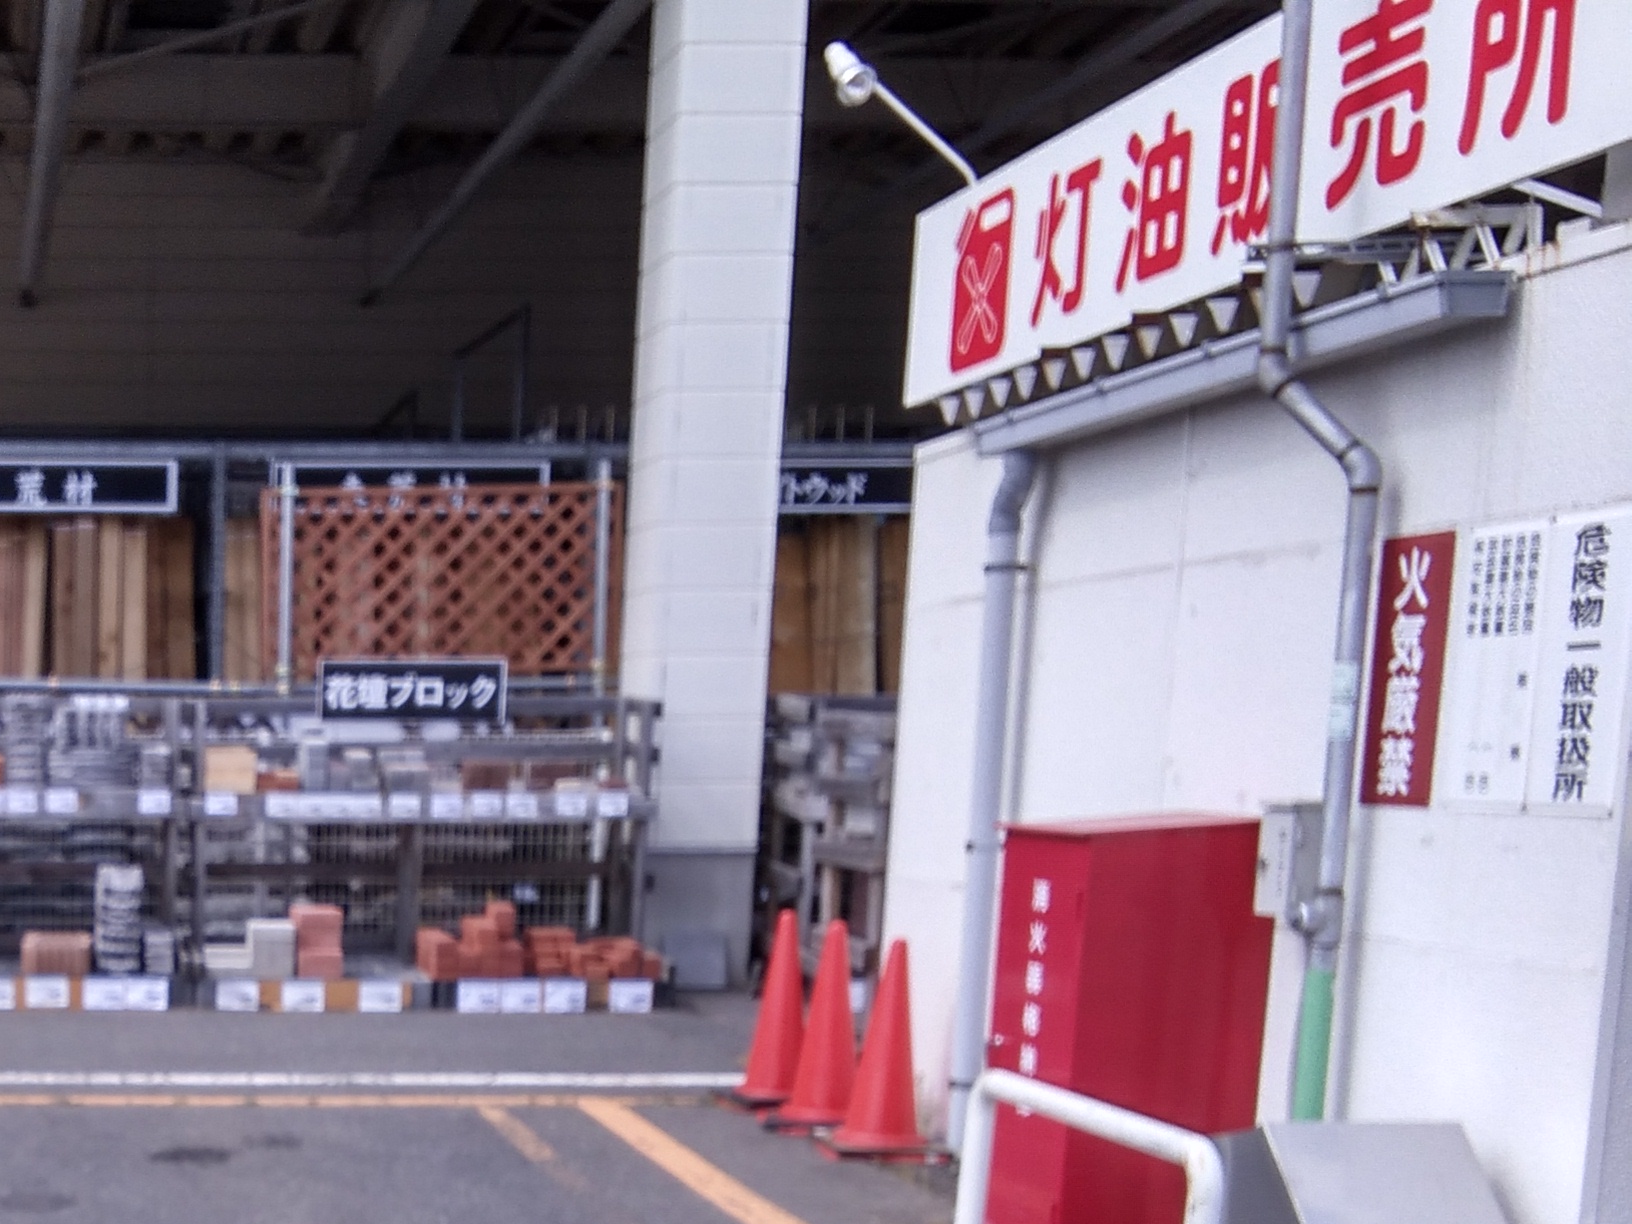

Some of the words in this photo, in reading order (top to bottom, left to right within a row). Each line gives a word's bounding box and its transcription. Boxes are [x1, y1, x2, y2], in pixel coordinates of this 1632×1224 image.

[325, 671, 496, 710] 花壇ブロック
[1376, 545, 1431, 797] 火気厳禁
[1552, 521, 1612, 802] 危険物一般取扱所
